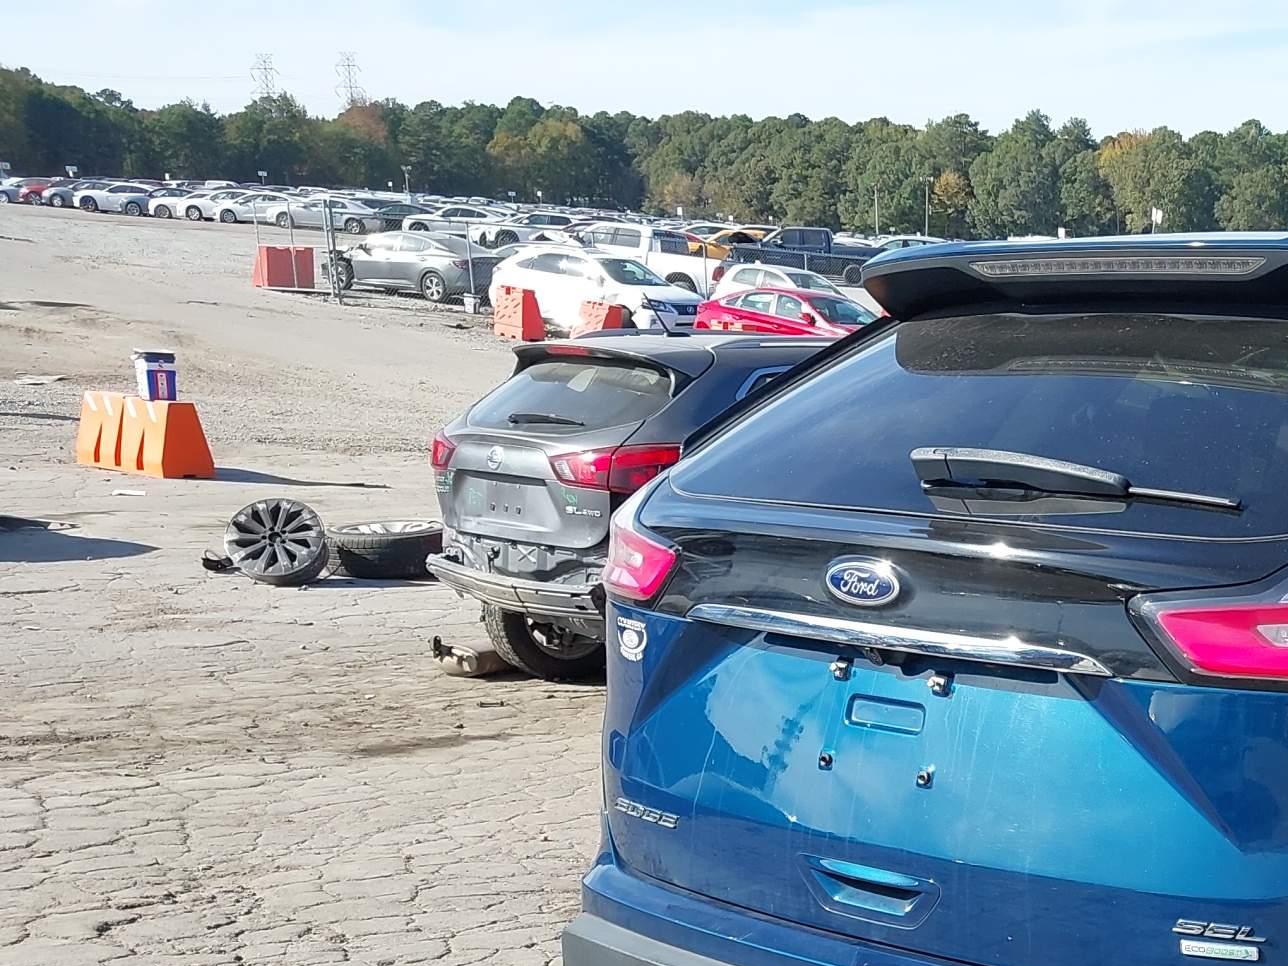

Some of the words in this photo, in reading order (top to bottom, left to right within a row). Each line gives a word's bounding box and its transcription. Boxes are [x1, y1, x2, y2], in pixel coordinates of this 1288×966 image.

[840, 569, 880, 596] Ford
[614, 797, 680, 829] EDGE
[1172, 918, 1267, 943] SEL
